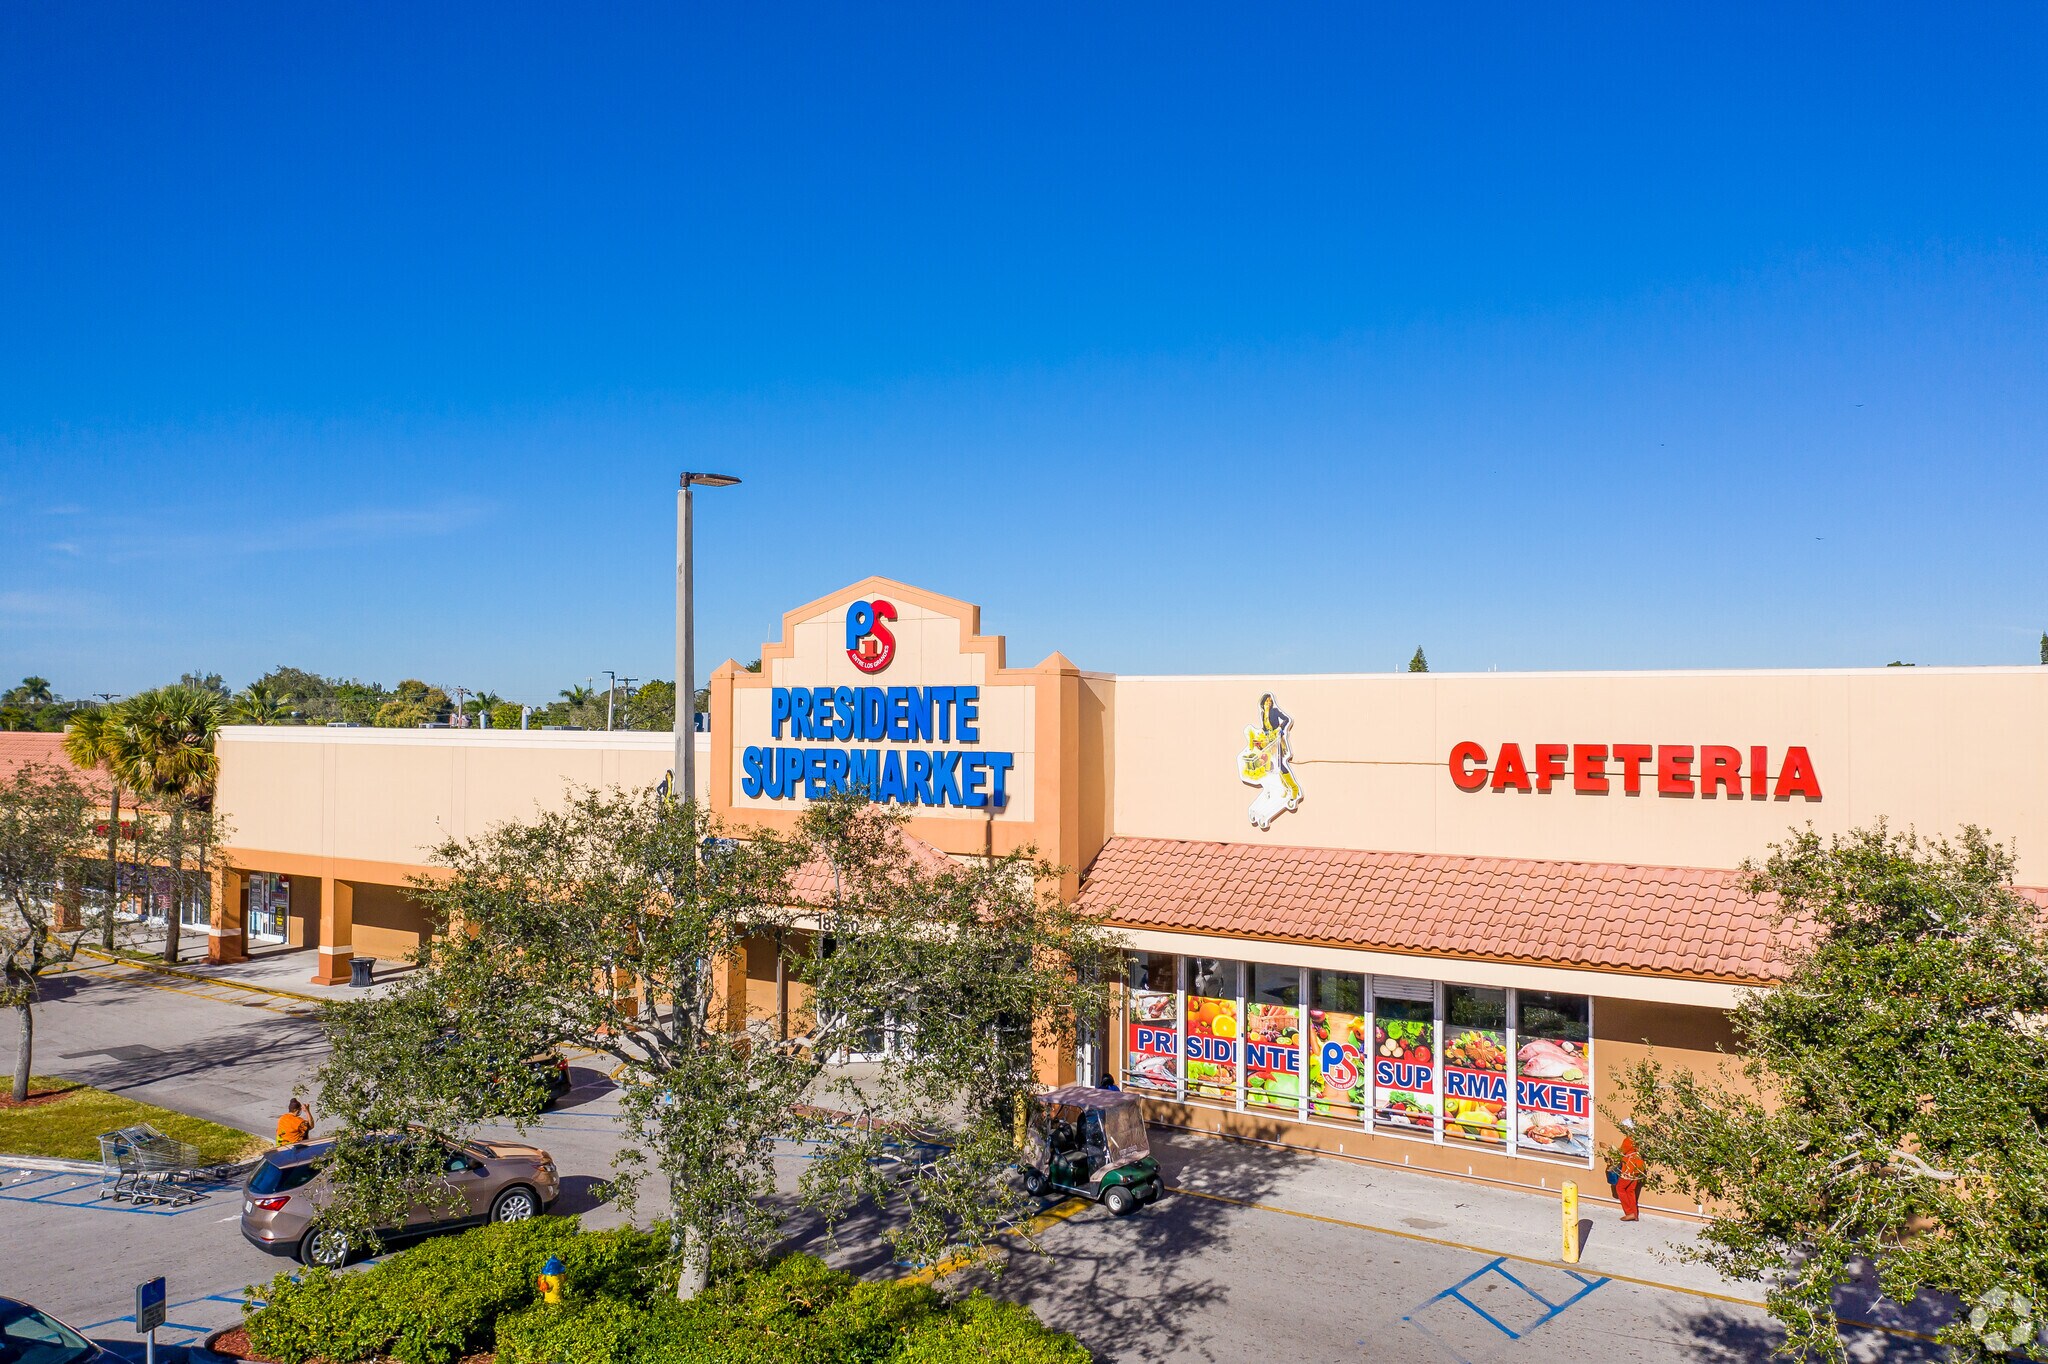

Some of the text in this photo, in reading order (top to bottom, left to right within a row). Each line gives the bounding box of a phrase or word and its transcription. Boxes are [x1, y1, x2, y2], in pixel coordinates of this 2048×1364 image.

[771, 686, 979, 742] PRESIDENTE
[742, 746, 1013, 807] SUPERMARKET
[1449, 741, 1822, 800] CAFETERIA
[1138, 1028, 1300, 1071] PRSIDNTE
[1376, 1061, 1589, 1113] SUPRMARKET
